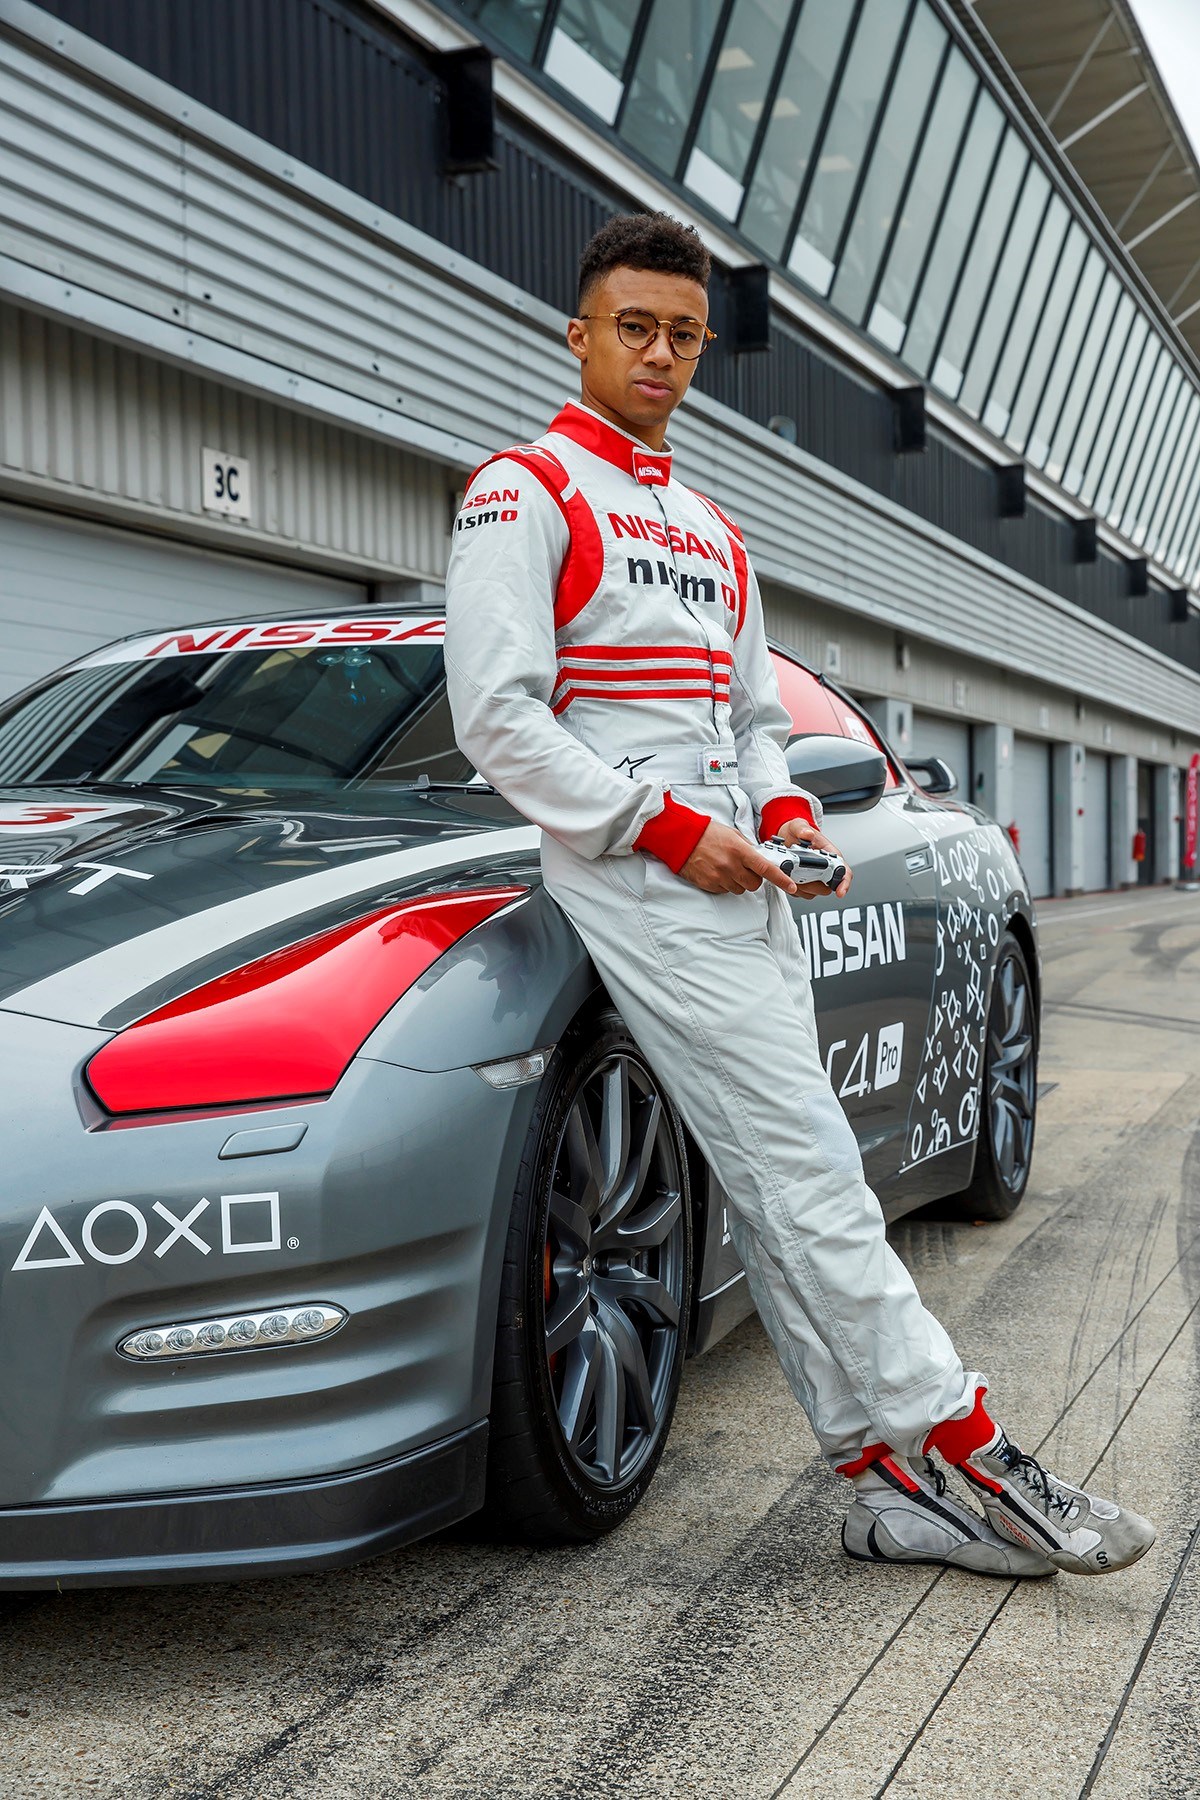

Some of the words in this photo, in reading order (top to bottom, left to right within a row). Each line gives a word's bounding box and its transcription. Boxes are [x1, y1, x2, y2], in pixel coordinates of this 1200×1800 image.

[215, 464, 239, 501] 3C
[461, 489, 519, 511] SSAN
[457, 510, 518, 531] ismo
[607, 512, 730, 571] NISSAN
[627, 557, 736, 612] nismo
[143, 620, 446, 657] NISSA
[880, 1041, 899, 1075] Pro
